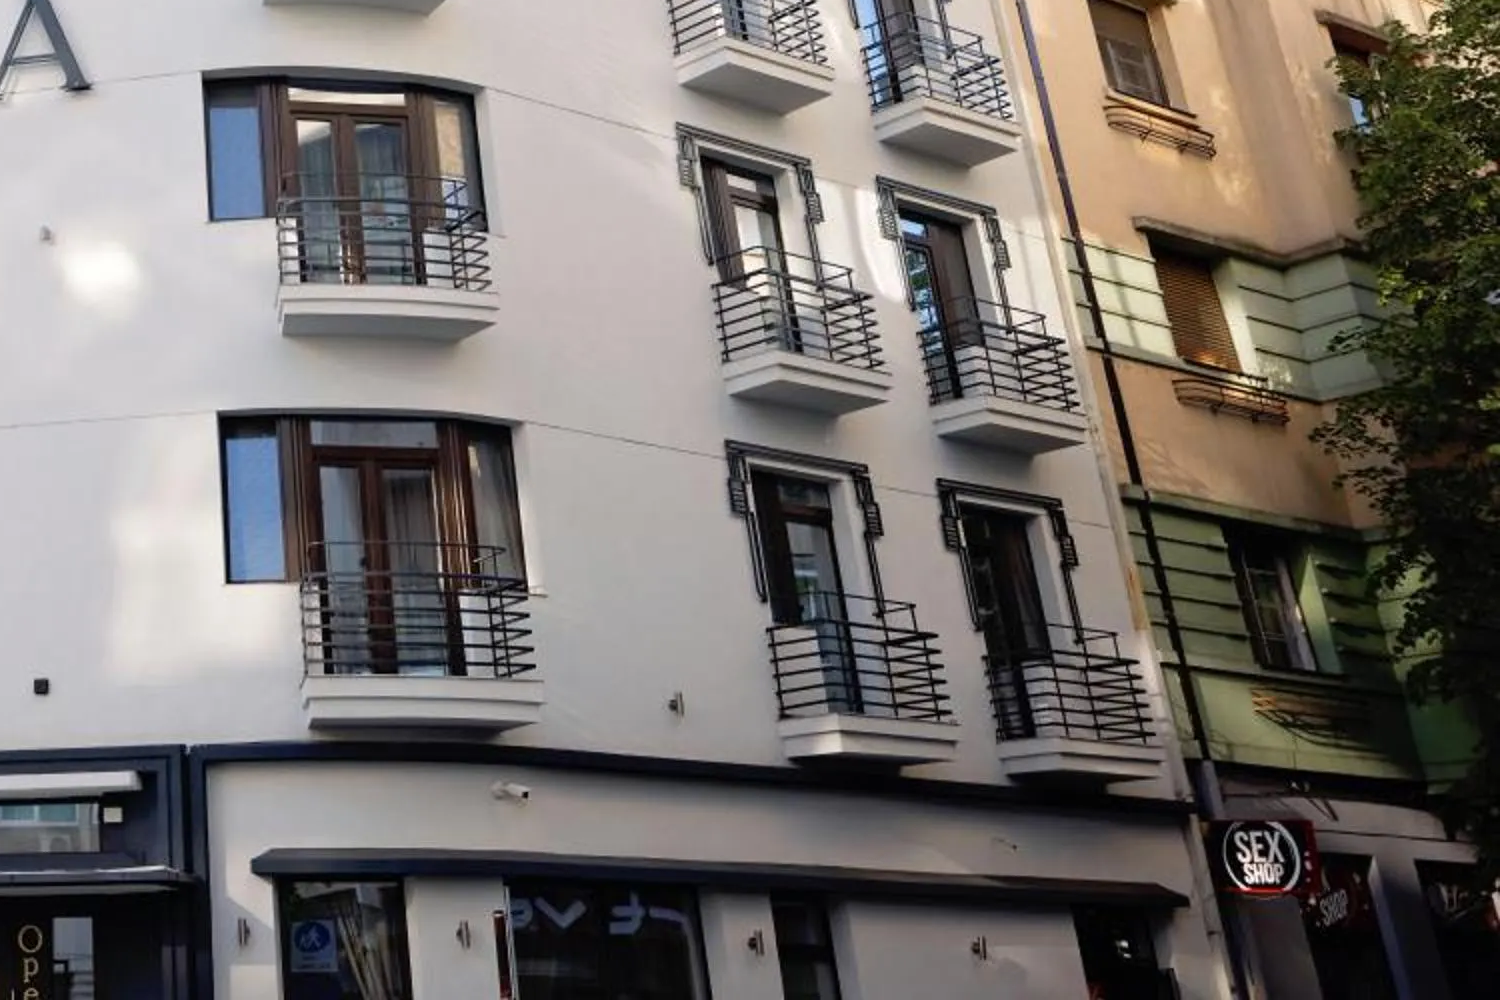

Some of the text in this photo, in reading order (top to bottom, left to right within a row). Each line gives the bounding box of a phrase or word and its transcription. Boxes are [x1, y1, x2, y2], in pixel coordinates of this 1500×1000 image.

[1233, 830, 1285, 863] SEX
[1243, 862, 1285, 885] SHOP
[1320, 889, 1349, 927] SHOP
